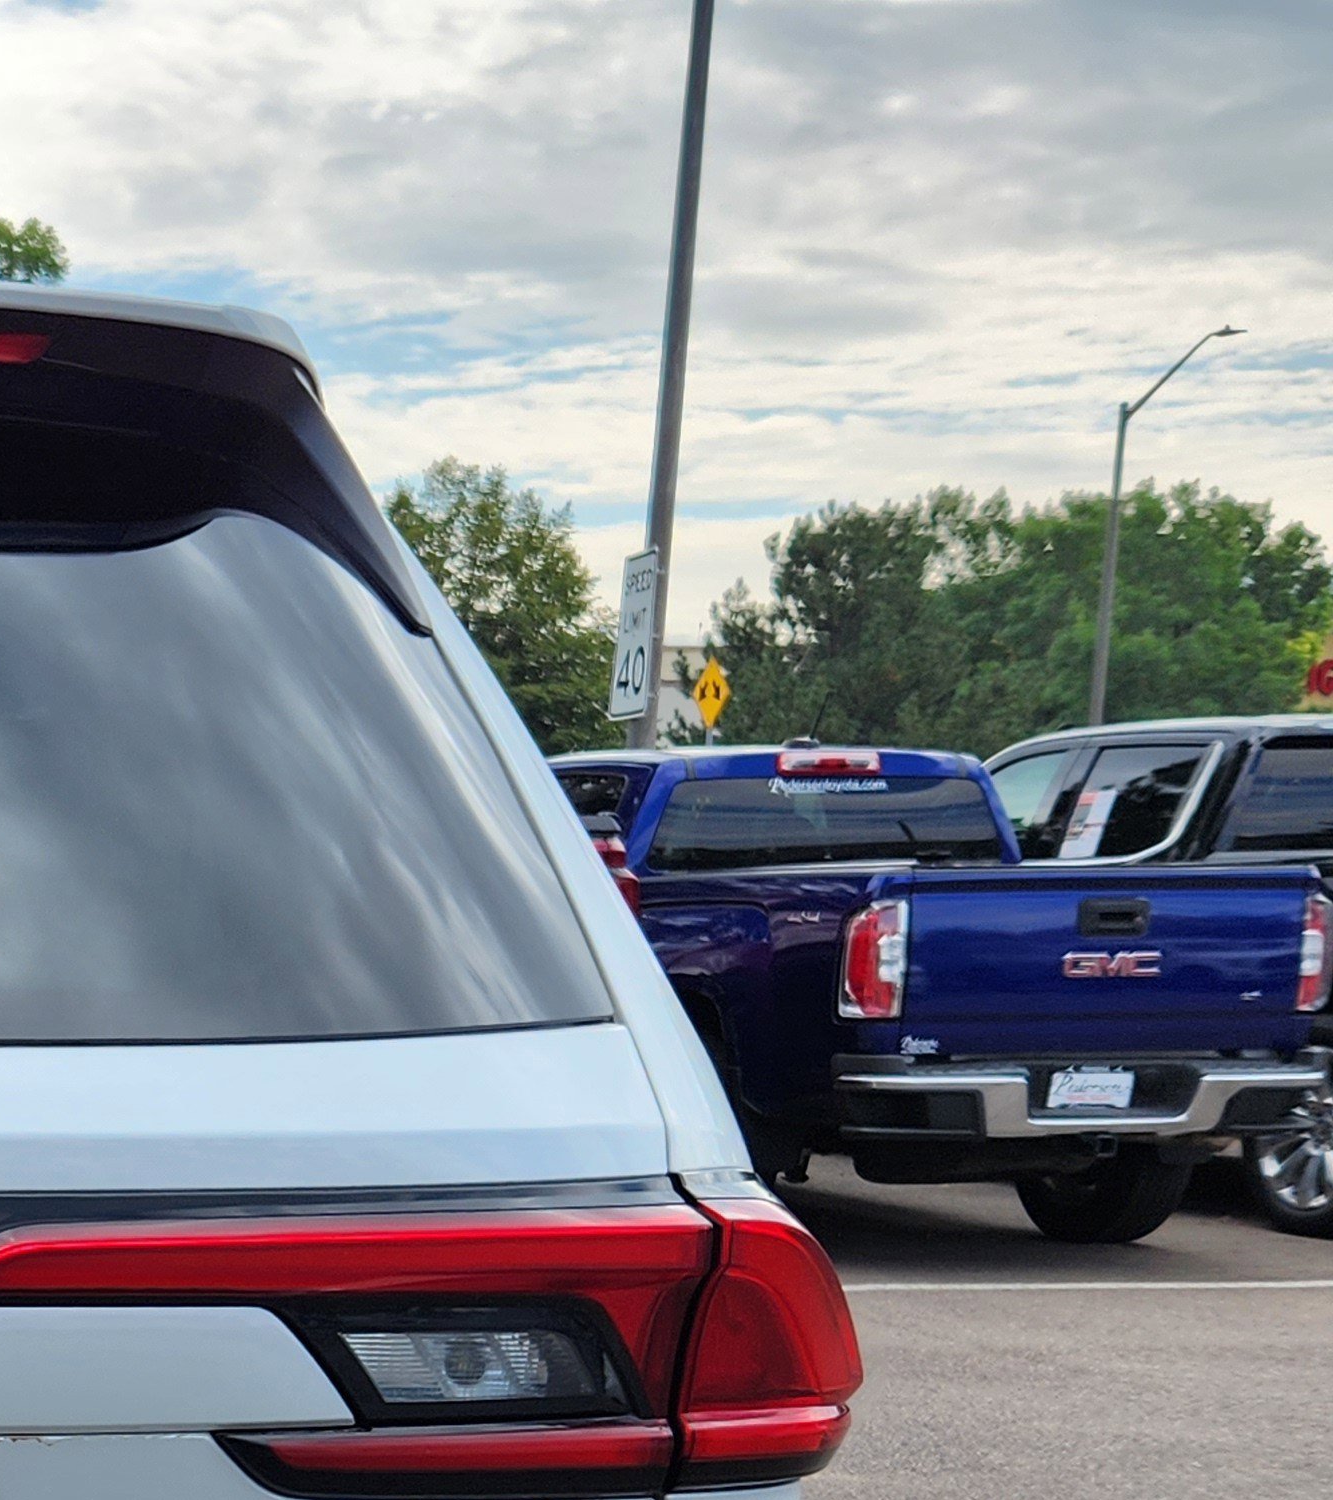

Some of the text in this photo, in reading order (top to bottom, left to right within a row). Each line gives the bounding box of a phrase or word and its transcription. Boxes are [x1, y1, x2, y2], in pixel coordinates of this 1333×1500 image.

[625, 567, 653, 597] SPEED
[623, 606, 647, 634] LIMIT
[617, 645, 645, 697] 40
[1062, 950, 1163, 978] GMC
